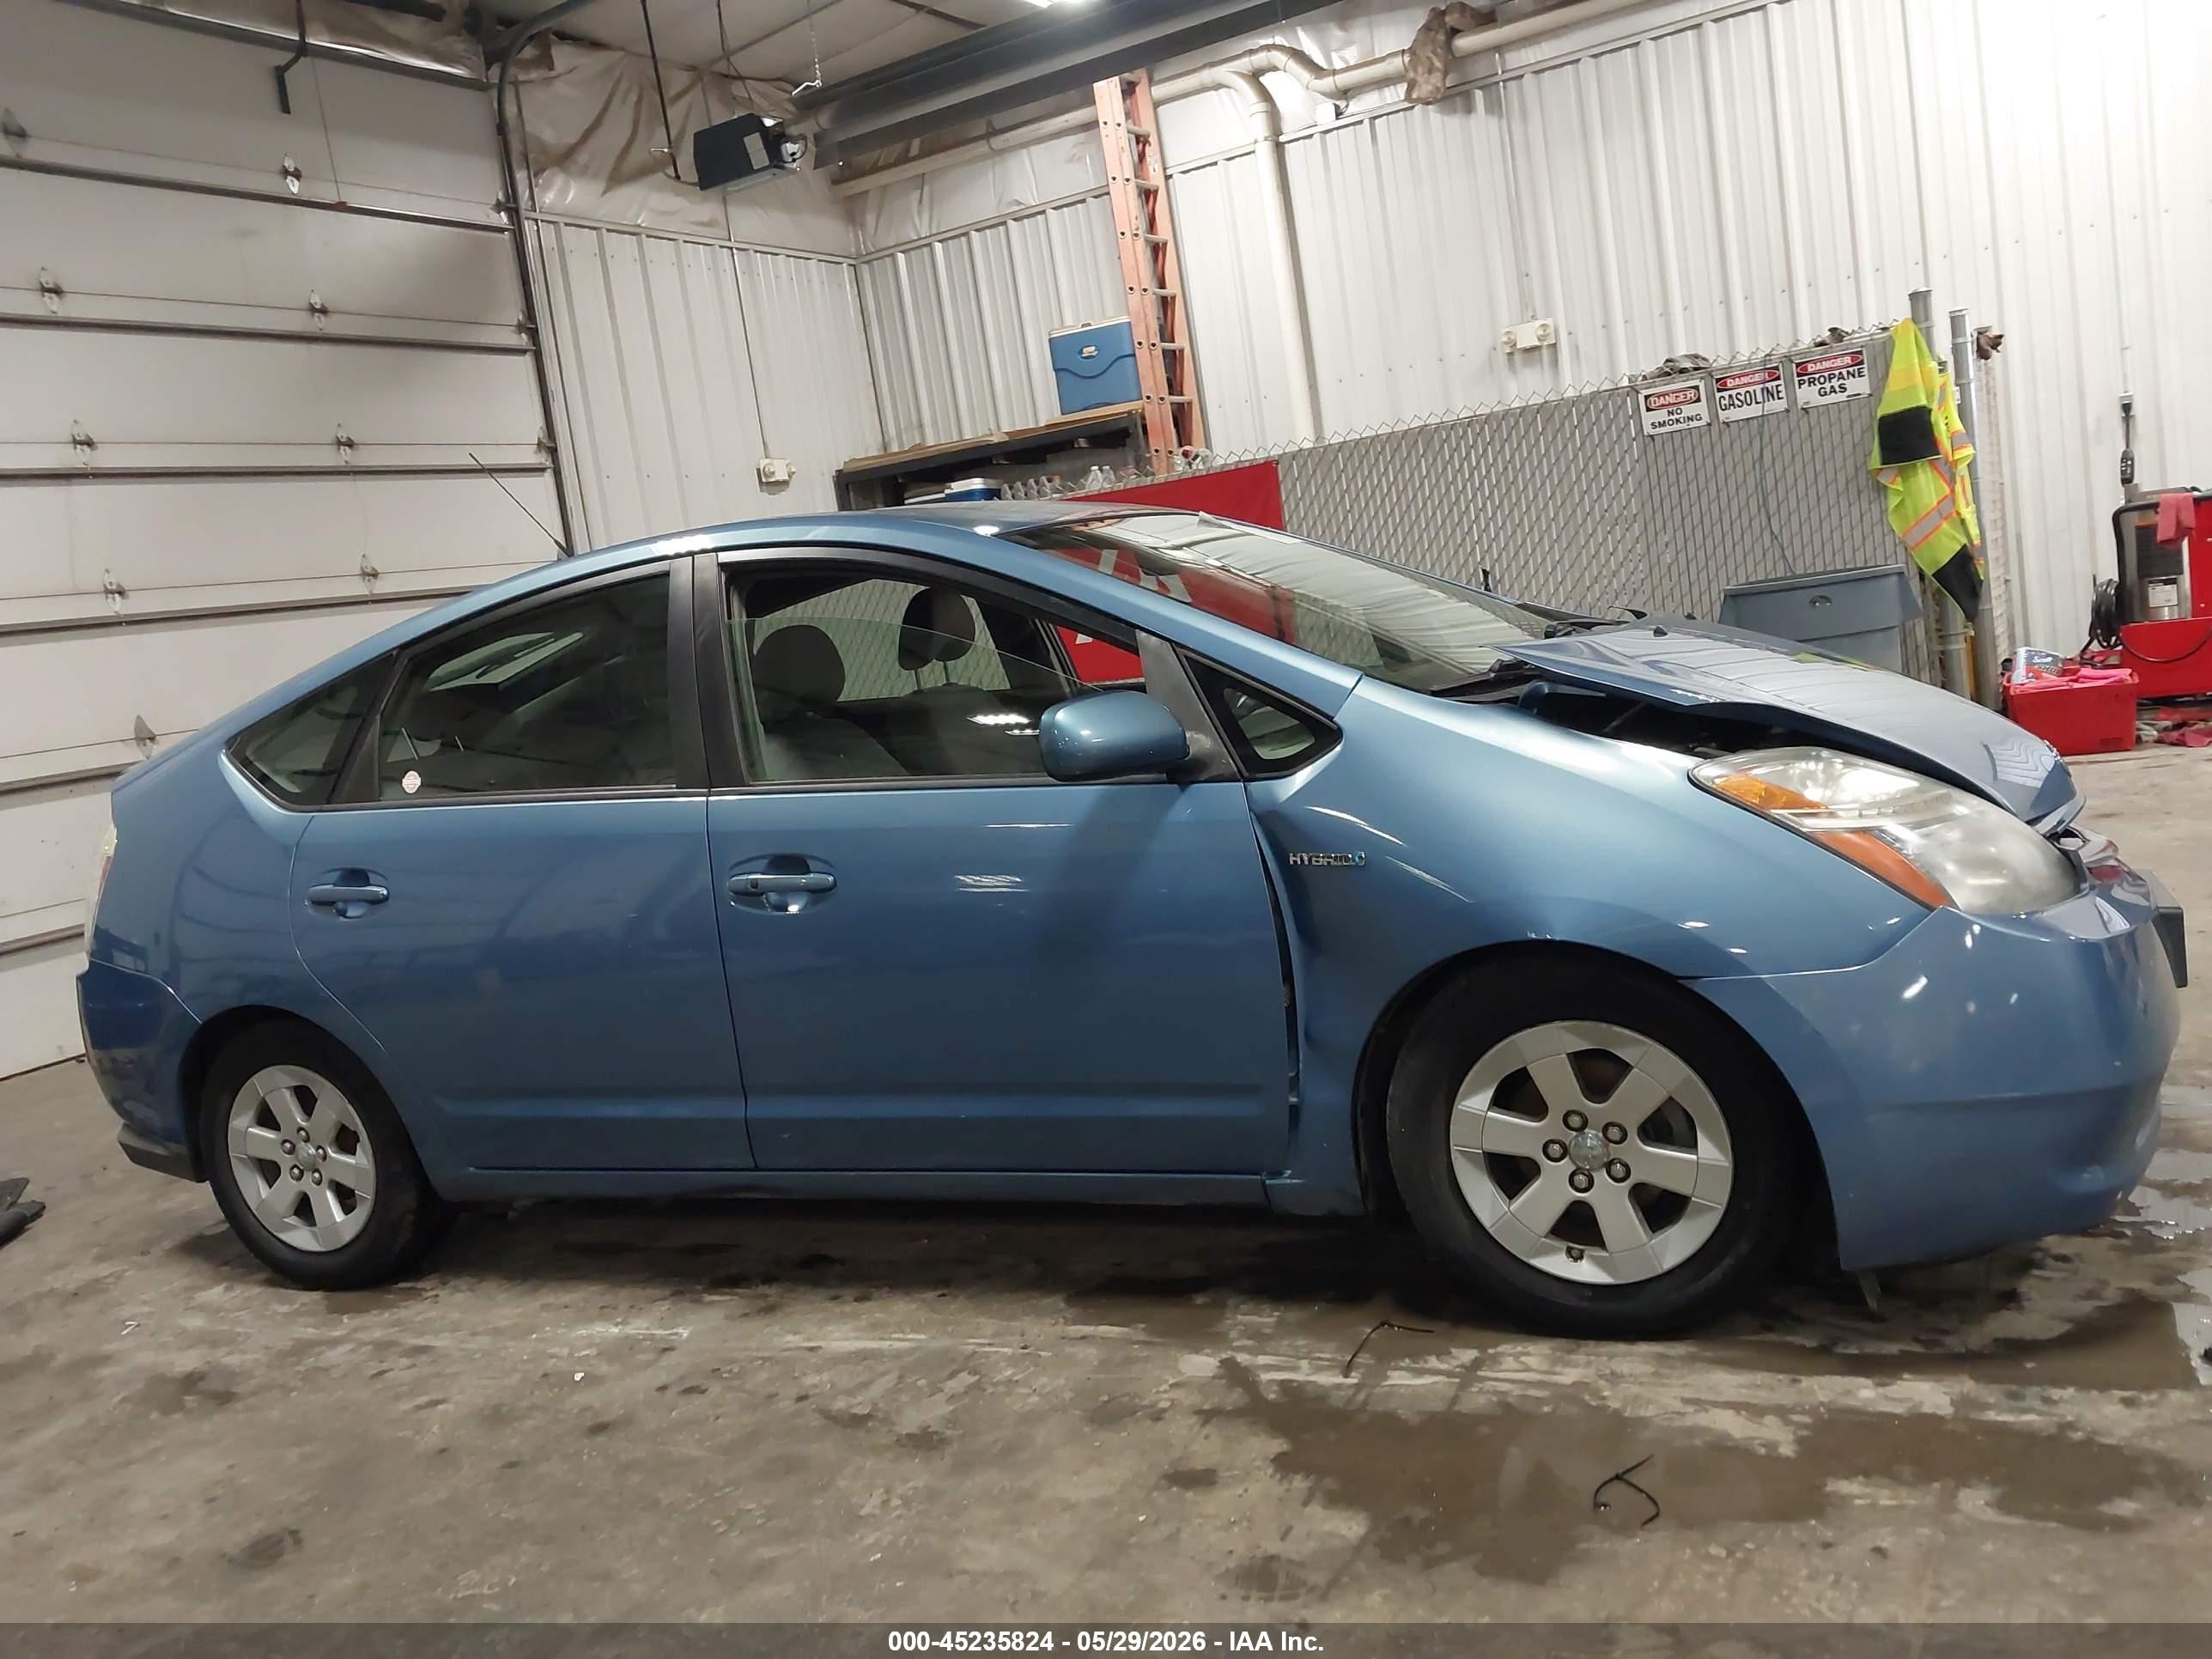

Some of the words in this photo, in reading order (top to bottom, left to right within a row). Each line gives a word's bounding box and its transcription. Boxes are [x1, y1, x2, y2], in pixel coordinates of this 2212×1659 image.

[1807, 356, 1851, 372] DANGER
[1797, 367, 1866, 389] PROPANE
[1718, 384, 1784, 411] GASOLINE
[1818, 383, 1848, 397] GAS
[1650, 390, 1695, 407] DANGER
[1667, 407, 1683, 416] NO
[1650, 413, 1703, 429] SMOKING
[1289, 852, 1354, 866] HYBRID
